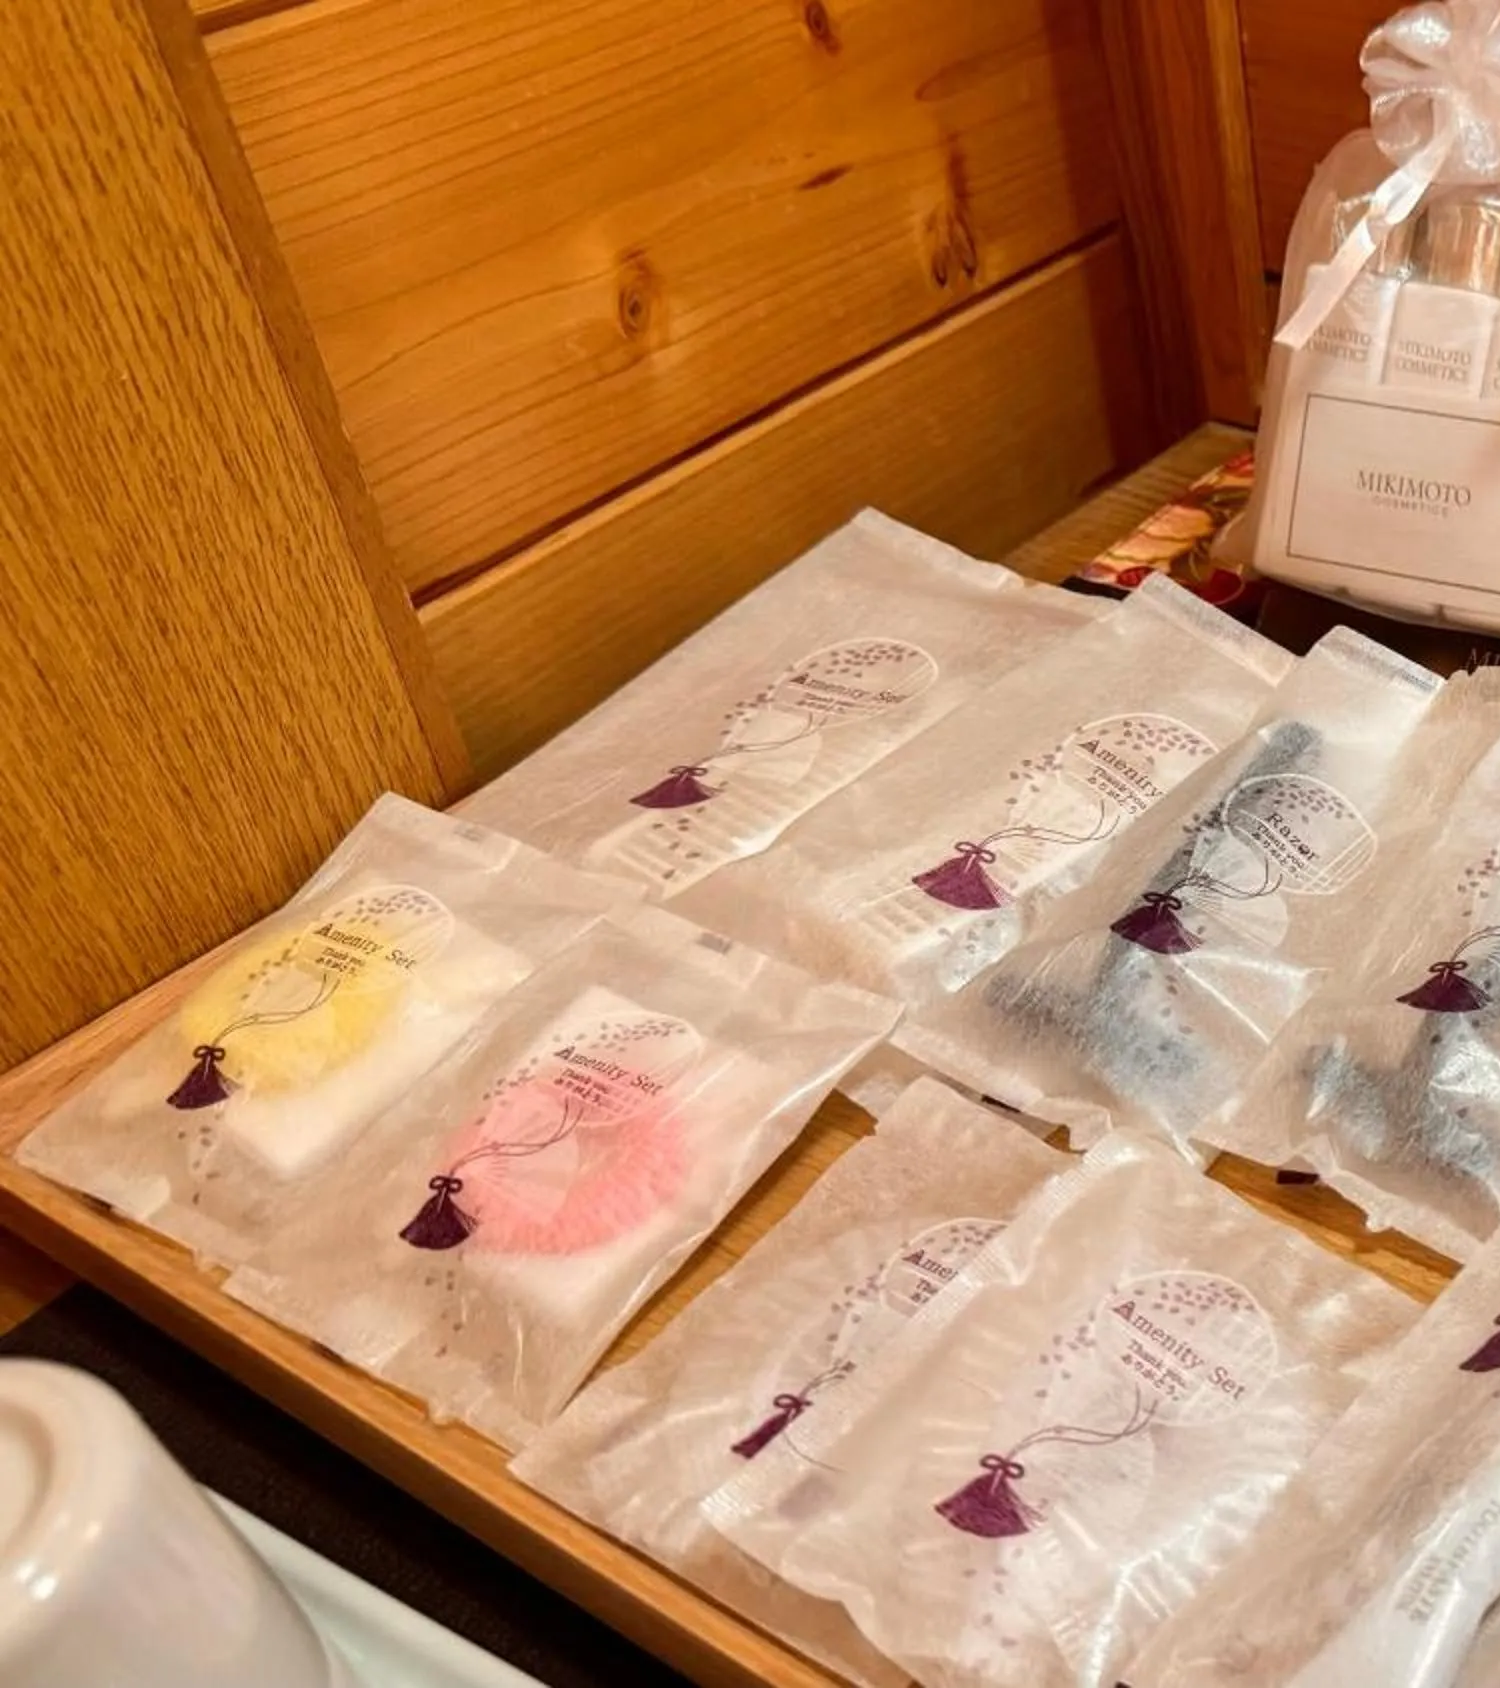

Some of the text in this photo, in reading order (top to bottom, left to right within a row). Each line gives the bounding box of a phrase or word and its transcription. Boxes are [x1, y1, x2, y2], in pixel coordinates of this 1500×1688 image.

[1395, 360, 1469, 385] COSMETICS
[1399, 340, 1472, 366] MIKIMOTO
[1356, 469, 1472, 507] MIKIMOTO
[1373, 496, 1449, 518] COSMETICS
[1077, 739, 1164, 797] Amenity
[1264, 812, 1318, 860] Razor
[313, 923, 416, 969] Amenity Set
[554, 1045, 664, 1096] Amenity Set
[1111, 1299, 1246, 1401] Amenity Set
